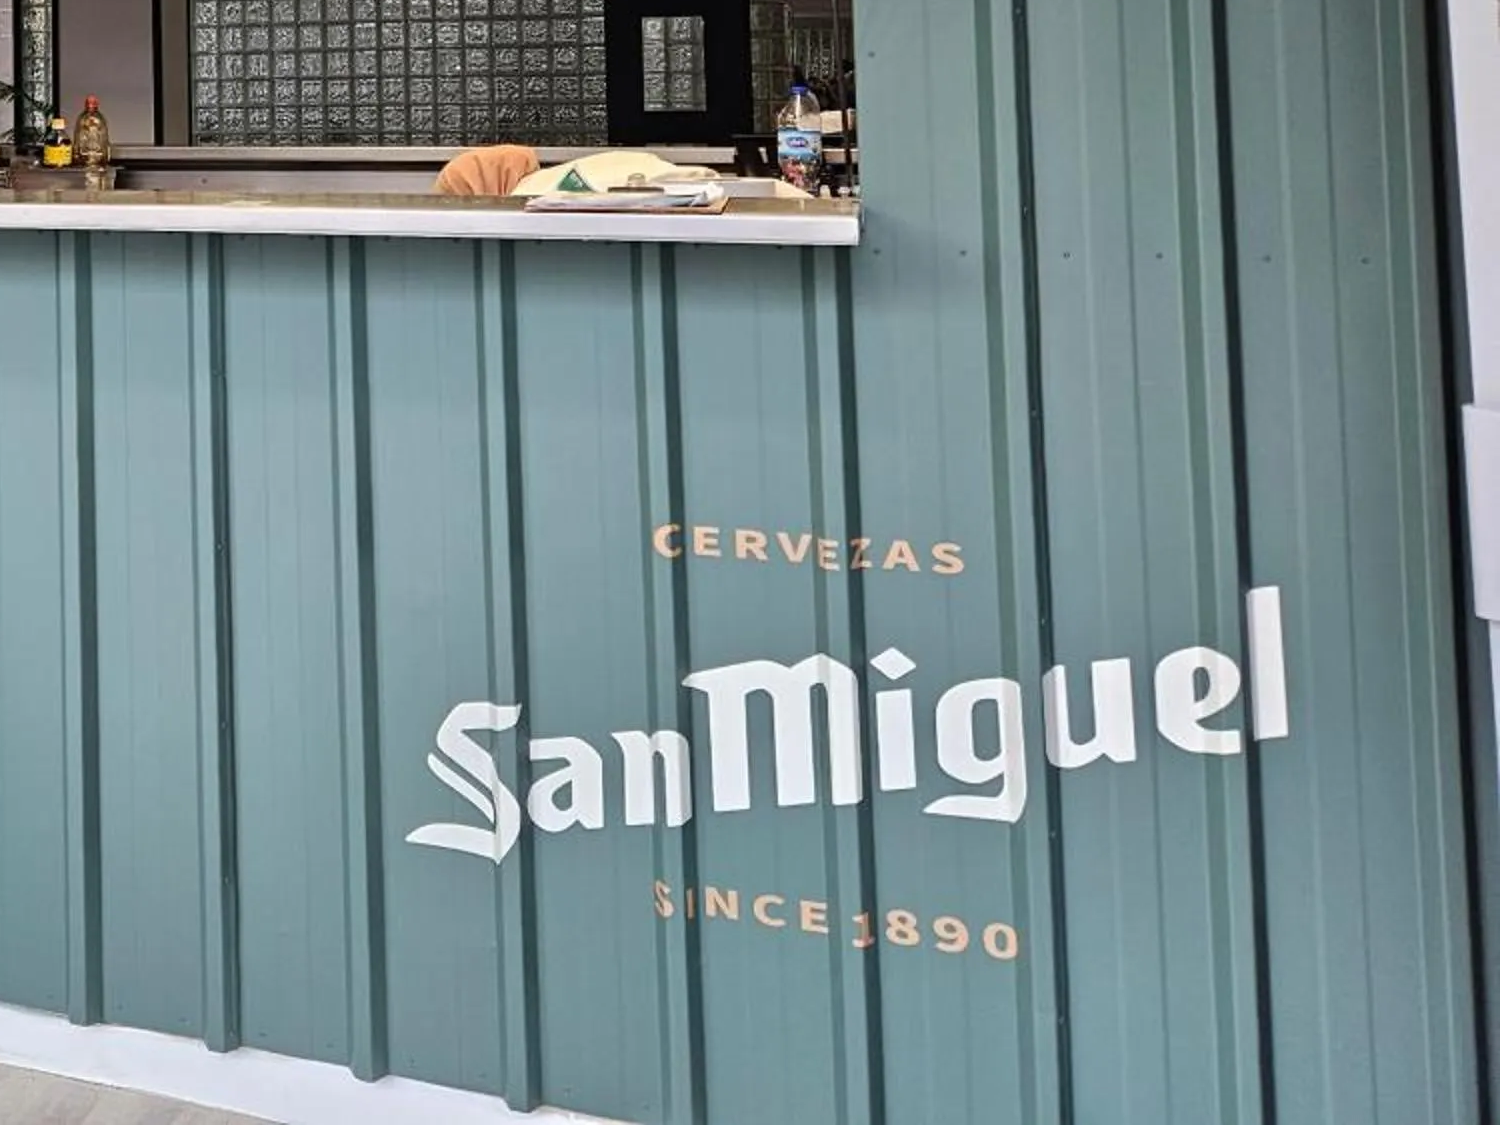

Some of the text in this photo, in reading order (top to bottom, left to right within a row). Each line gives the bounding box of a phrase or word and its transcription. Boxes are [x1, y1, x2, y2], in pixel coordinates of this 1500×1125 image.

[652, 523, 965, 574] CERVEZAS
[653, 879, 1019, 961] SINCE 1890
